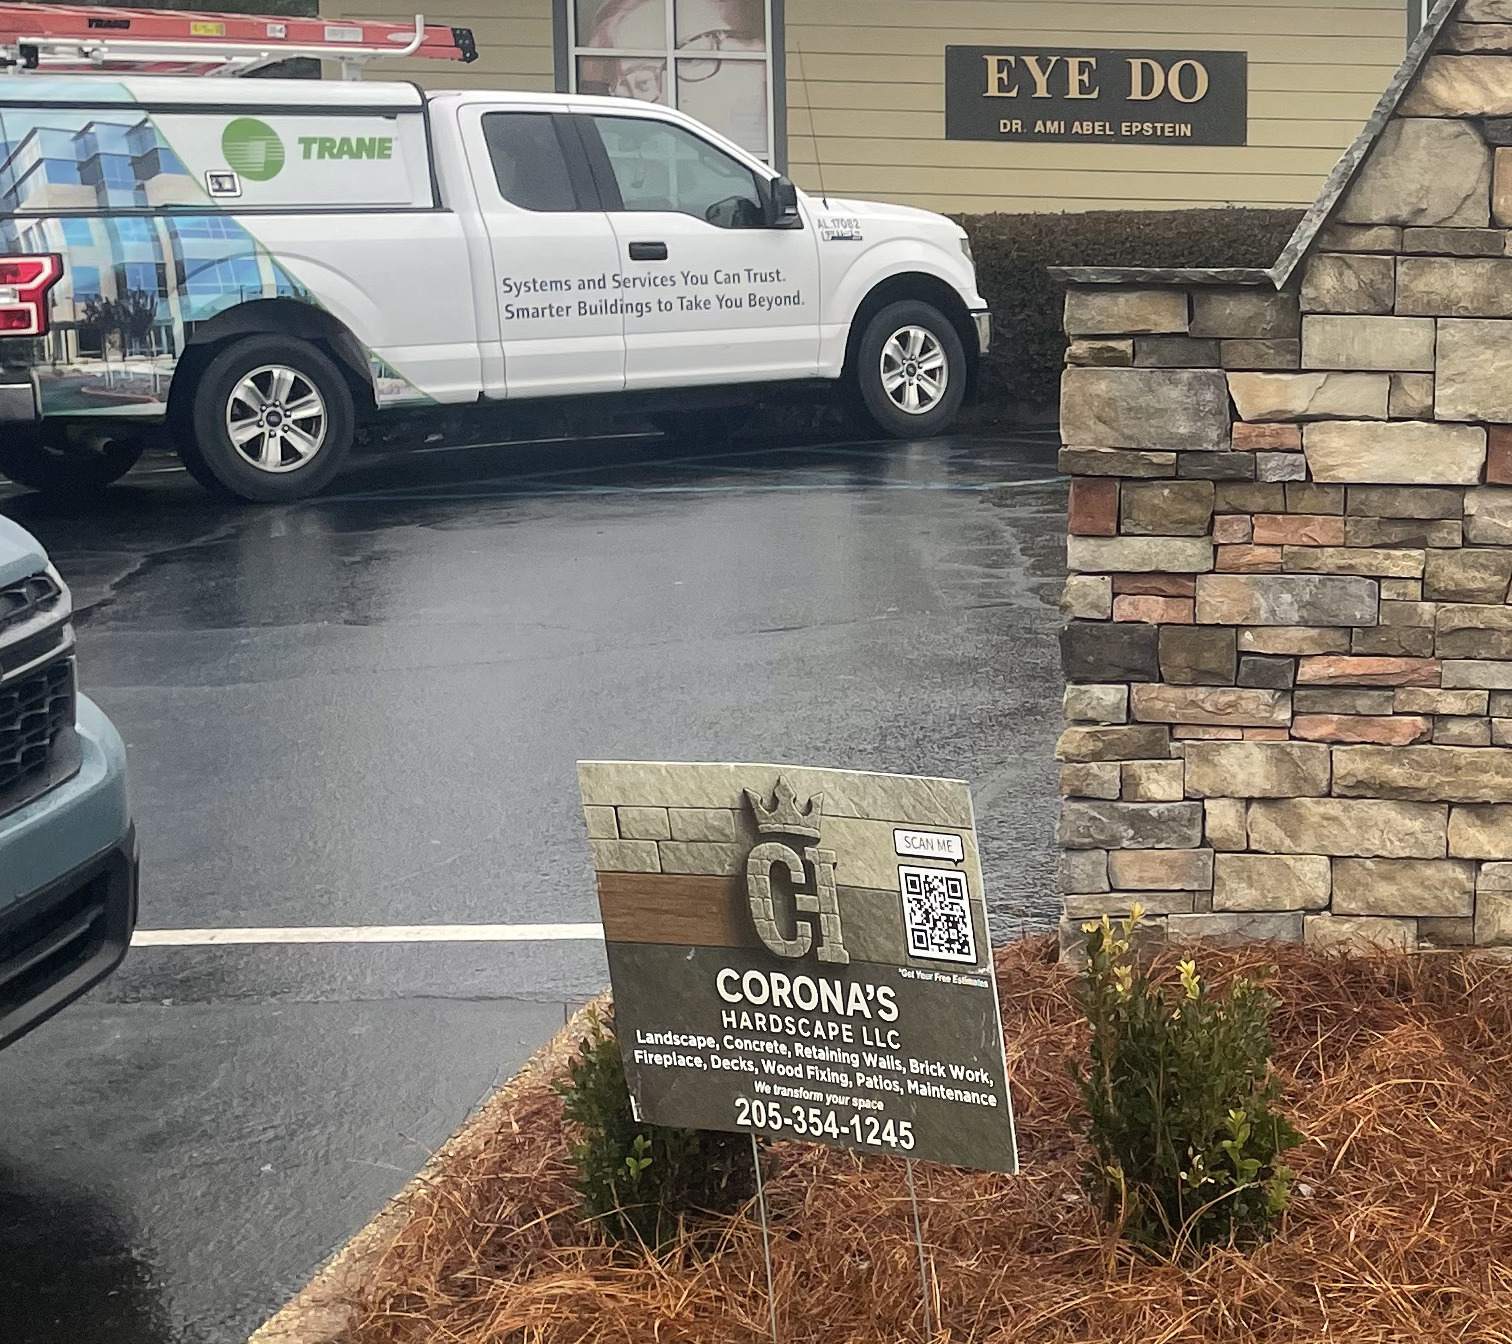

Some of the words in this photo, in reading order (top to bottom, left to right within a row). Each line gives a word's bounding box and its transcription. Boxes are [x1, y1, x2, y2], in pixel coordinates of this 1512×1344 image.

[982, 54, 1100, 99] EYE
[1125, 58, 1209, 103] DO
[999, 119, 1028, 134] DR.
[1034, 120, 1065, 134] AMI
[1071, 121, 1115, 135] ABEL
[1121, 122, 1192, 137] EPSTEIN
[297, 137, 393, 160] TRANE
[502, 277, 572, 298] Systems
[577, 273, 607, 290] and
[611, 272, 677, 289] Services
[680, 270, 709, 286] You
[713, 269, 741, 285] Can
[743, 268, 787, 283] Trust.
[504, 303, 572, 320] Smarter
[577, 298, 652, 318] Buildings
[657, 298, 673, 312] to
[676, 294, 712, 311] Take
[715, 294, 743, 309] You
[748, 290, 805, 311] Beyond.
[904, 835, 935, 851] SCAN
[936, 838, 954, 853] ME
[934, 972, 952, 983] Free
[716, 968, 899, 1022] CORONA'S
[721, 1009, 854, 1043] HARDSCAPE
[862, 1025, 901, 1050] LLC
[635, 1029, 720, 1051] Landscape,
[722, 1035, 792, 1058] Concrete,
[794, 1042, 860, 1068] Retaining
[862, 1051, 907, 1075] Walls,
[908, 1058, 947, 1079] Brick
[949, 1063, 995, 1088] Work,
[633, 1049, 708, 1071] Fireplace,
[710, 1054, 759, 1075] Decks,
[761, 1059, 804, 1079] Wood
[806, 1065, 854, 1089] Fixing,
[855, 1072, 905, 1096] Patios,
[906, 1079, 998, 1107] Maintenance
[753, 1080, 771, 1095] We
[773, 1083, 824, 1102] transform
[825, 1092, 851, 1106] your
[851, 1097, 885, 1111] space
[734, 1097, 916, 1150] 205-354-1245
